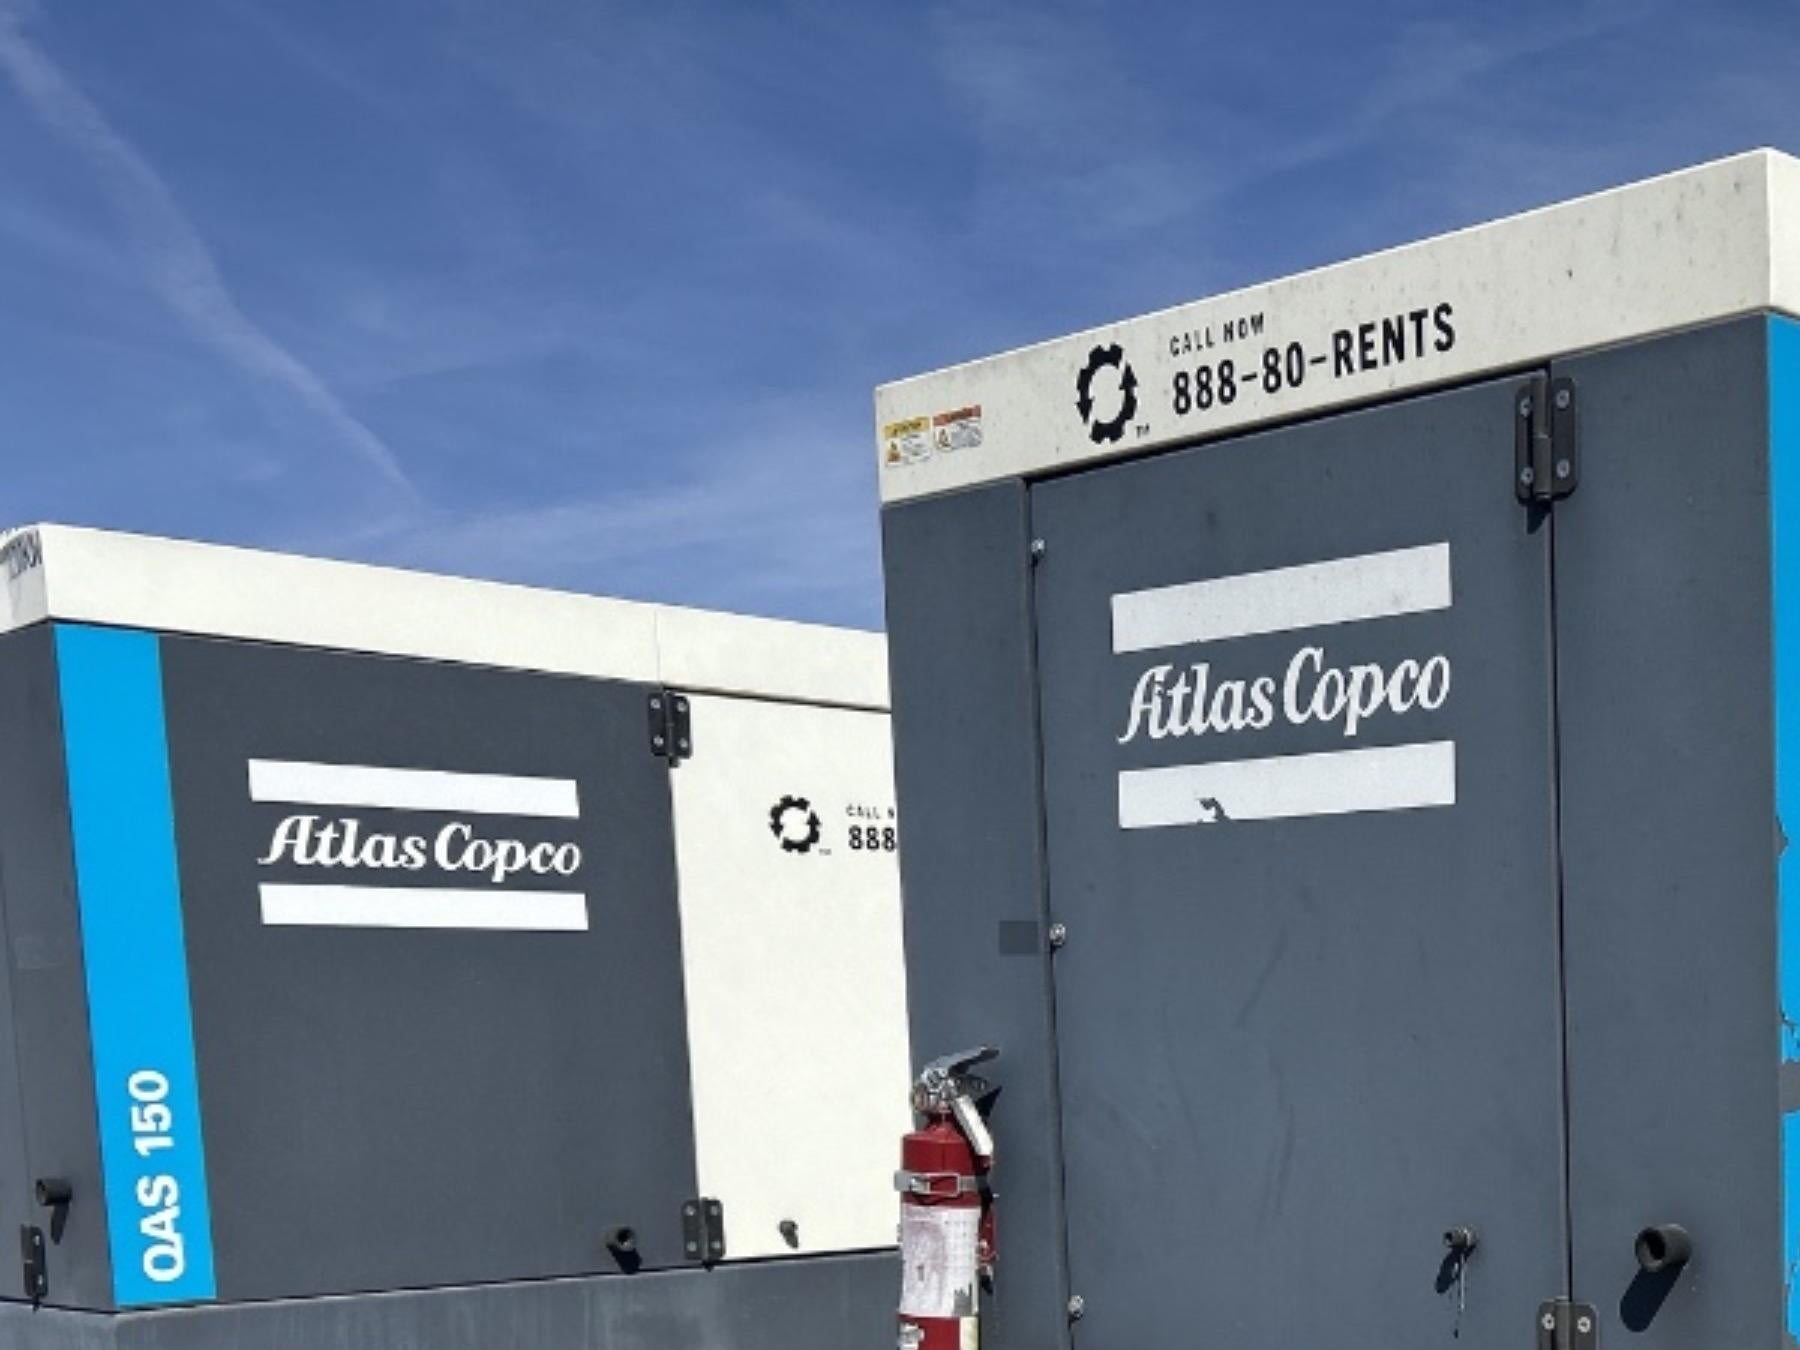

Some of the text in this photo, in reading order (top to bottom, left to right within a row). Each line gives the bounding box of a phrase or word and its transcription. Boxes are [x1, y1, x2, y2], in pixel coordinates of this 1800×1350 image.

[1169, 312, 1265, 357] CALL NOW
[1172, 302, 1456, 415] 888-80-RENTS
[1117, 647, 1450, 744] Atlas Copco
[257, 813, 582, 882] Atlas Copco
[128, 1069, 186, 1283] QAS 150
